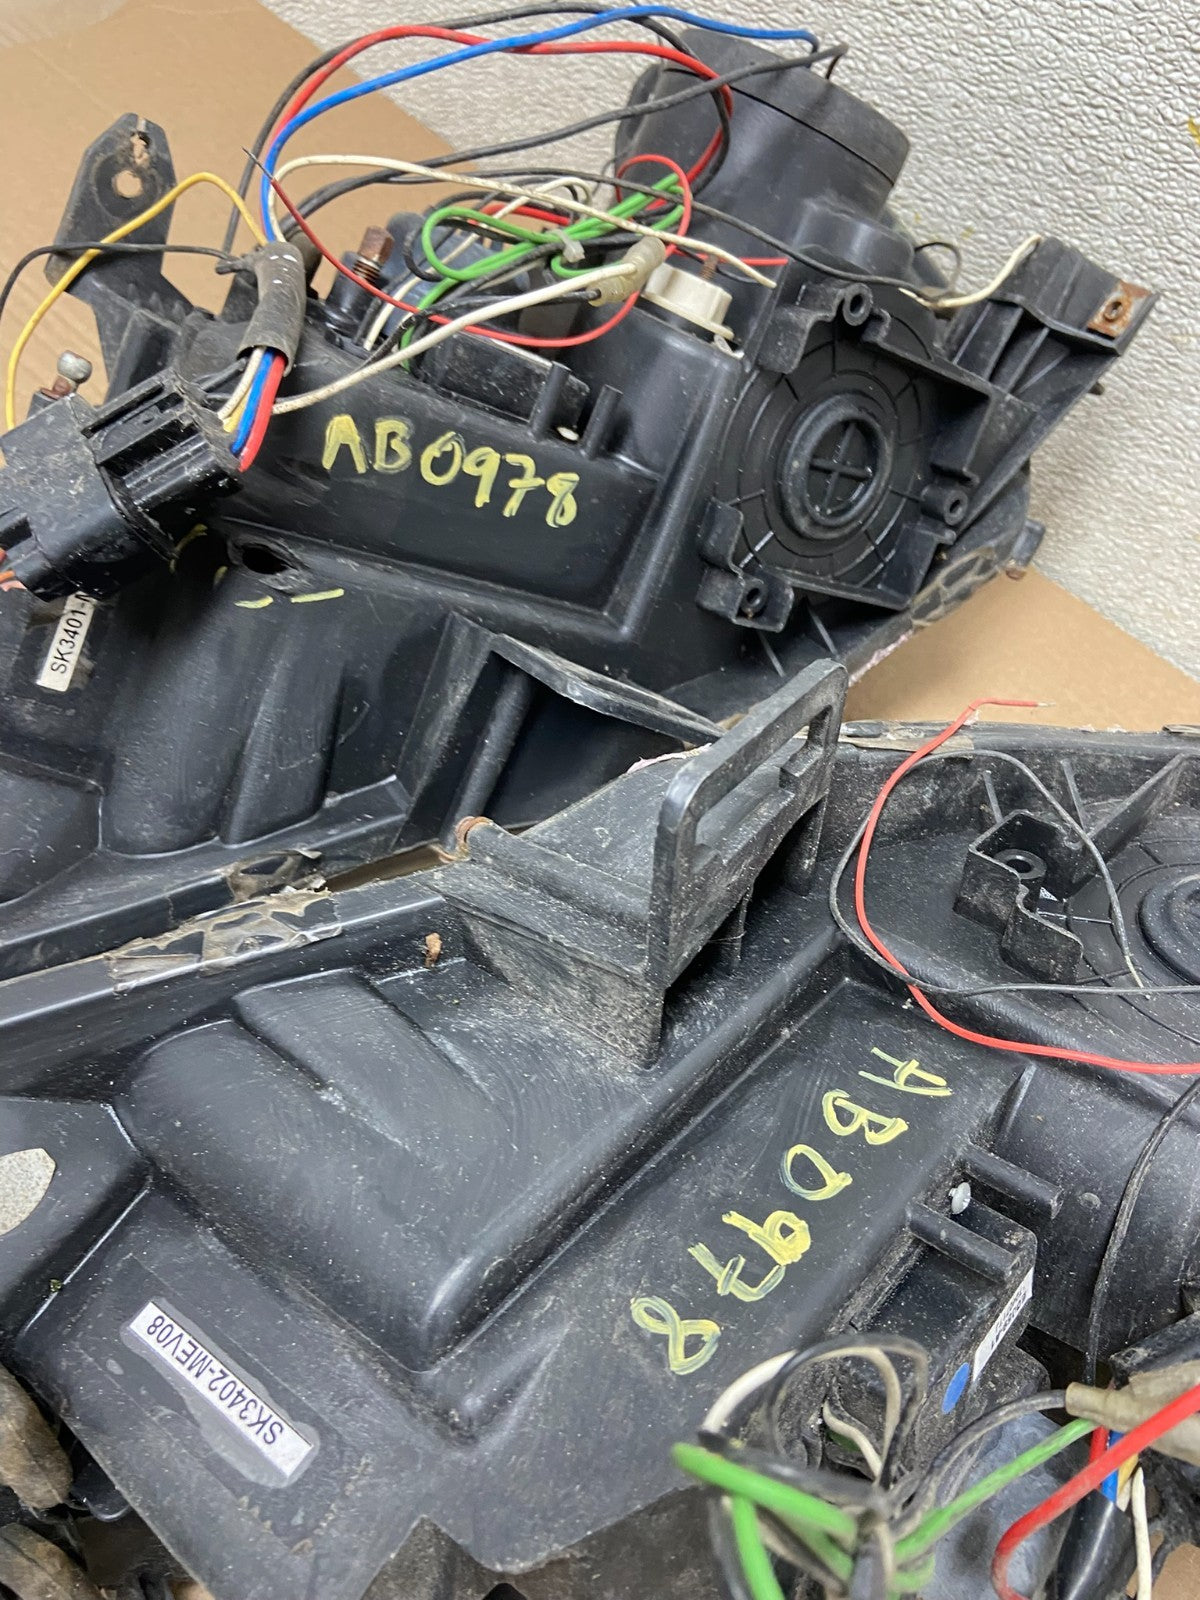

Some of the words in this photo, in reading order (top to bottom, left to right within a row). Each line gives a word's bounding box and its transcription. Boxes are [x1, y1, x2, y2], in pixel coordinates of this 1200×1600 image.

[322, 414, 580, 528] AB0978
[630, 1047, 953, 1376] AB0978
[146, 1315, 284, 1445] SK3402-MEV08
